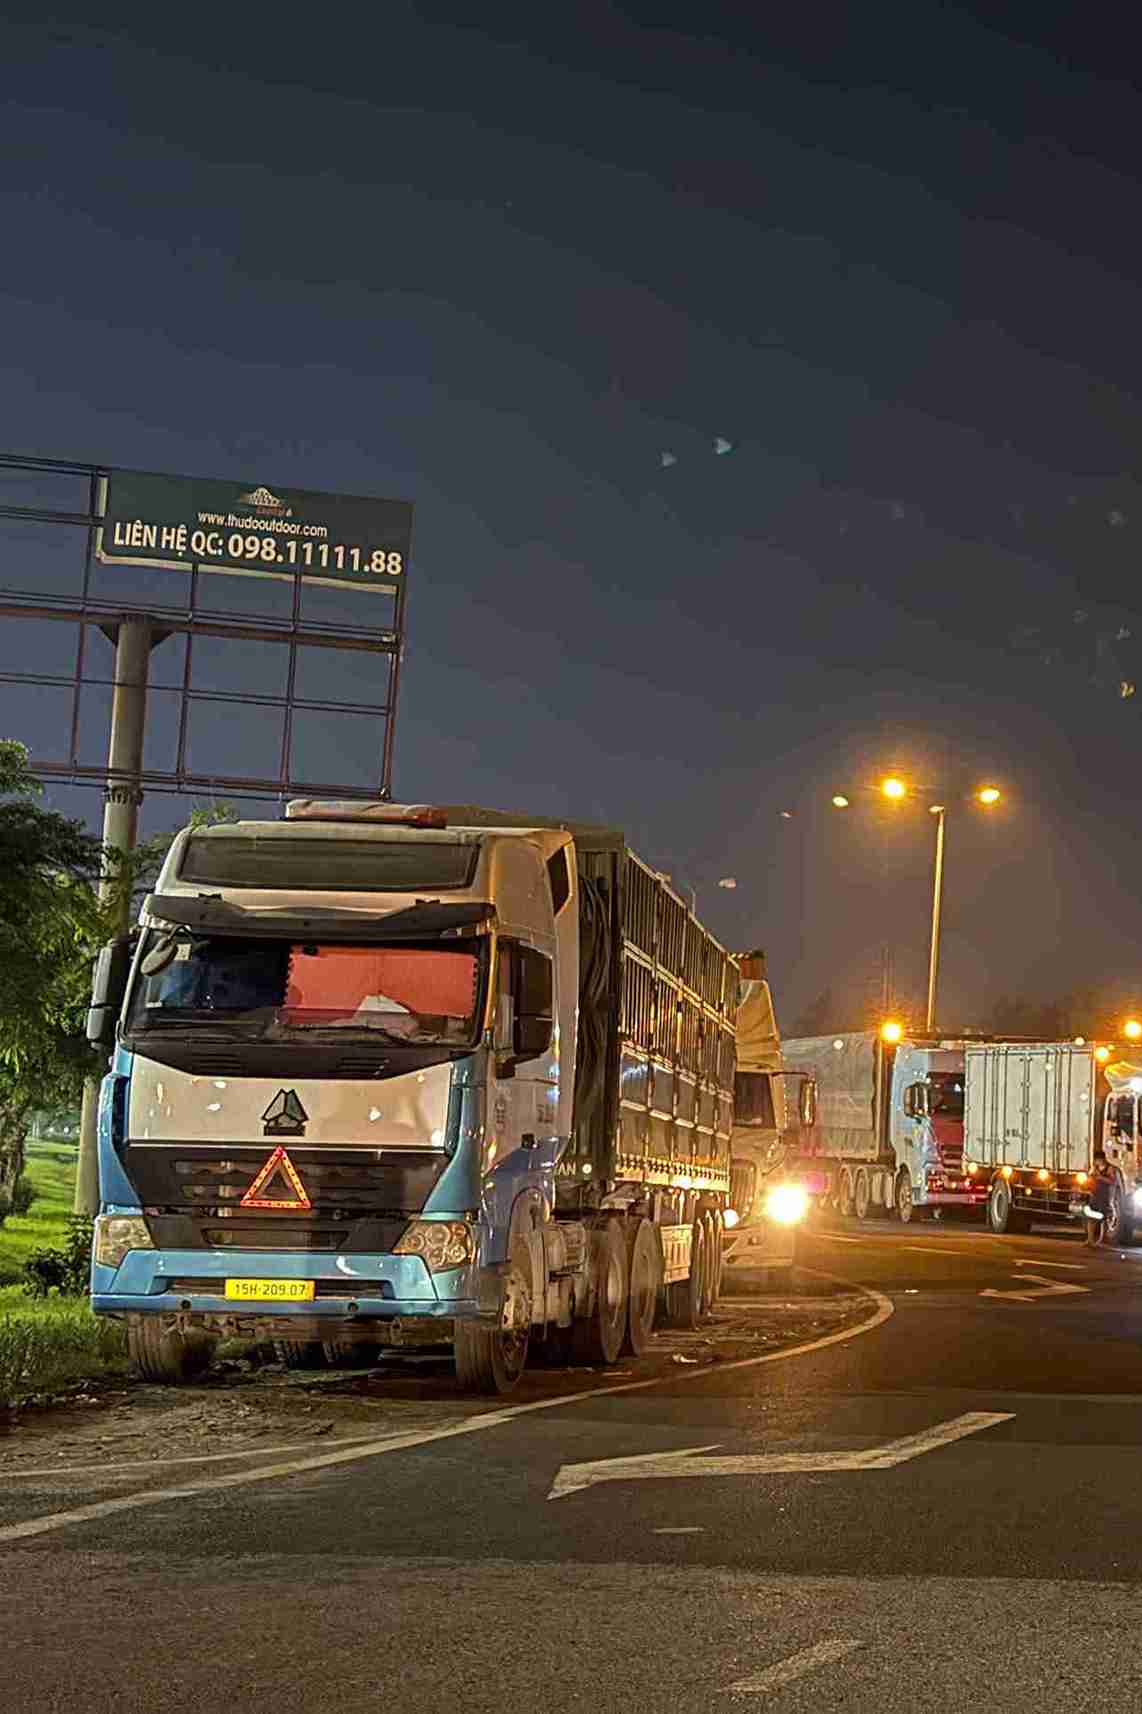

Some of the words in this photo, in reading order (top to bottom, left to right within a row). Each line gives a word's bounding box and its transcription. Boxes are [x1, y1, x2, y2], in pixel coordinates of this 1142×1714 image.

[198, 511, 328, 537] www.thudooutdoor.com
[113, 519, 157, 548] LIÊN
[161, 524, 187, 557] HỆ
[191, 530, 223, 556] QC:
[227, 534, 402, 575] 098.11111.88
